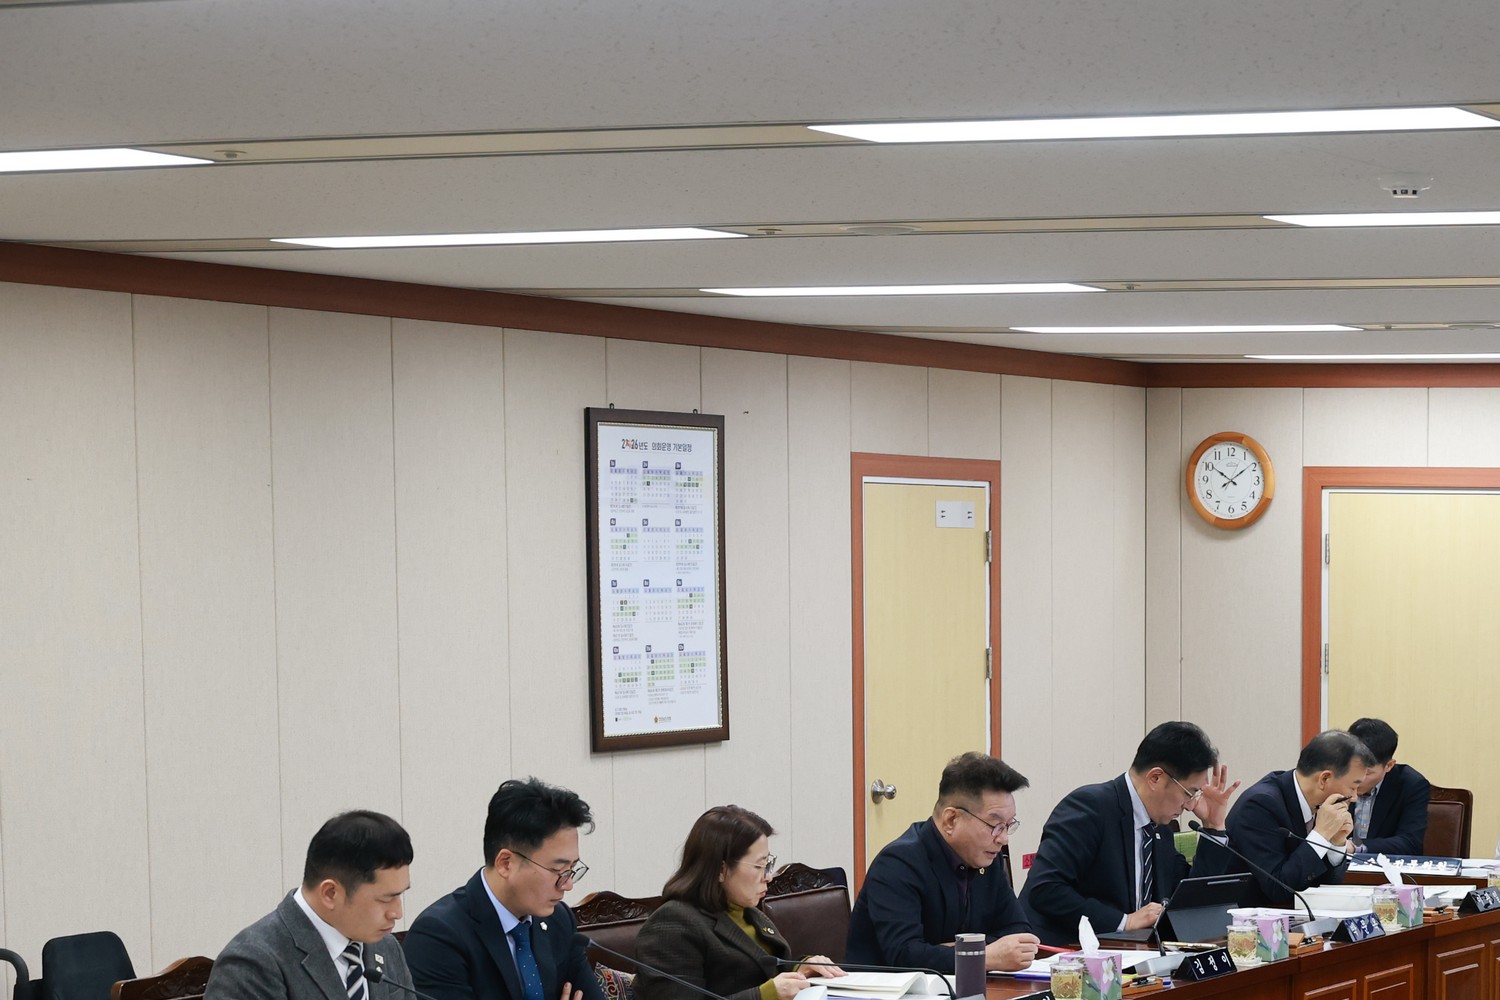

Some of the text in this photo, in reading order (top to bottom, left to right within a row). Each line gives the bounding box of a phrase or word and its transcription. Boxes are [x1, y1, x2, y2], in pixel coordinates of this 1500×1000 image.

[1214, 450, 1221, 460] 11
[1227, 447, 1236, 457] 12
[1243, 451, 1247, 461] 1
[1204, 461, 1214, 471] 10
[1251, 462, 1257, 472] 2
[1202, 475, 1209, 484] 9
[1253, 475, 1260, 486] 3
[1205, 489, 1213, 499] 8
[1249, 490, 1255, 499] 4
[1215, 500, 1221, 511] 7
[1227, 504, 1235, 514] 6
[1240, 501, 1248, 511] 5
[1194, 951, 1232, 975] 김정이
